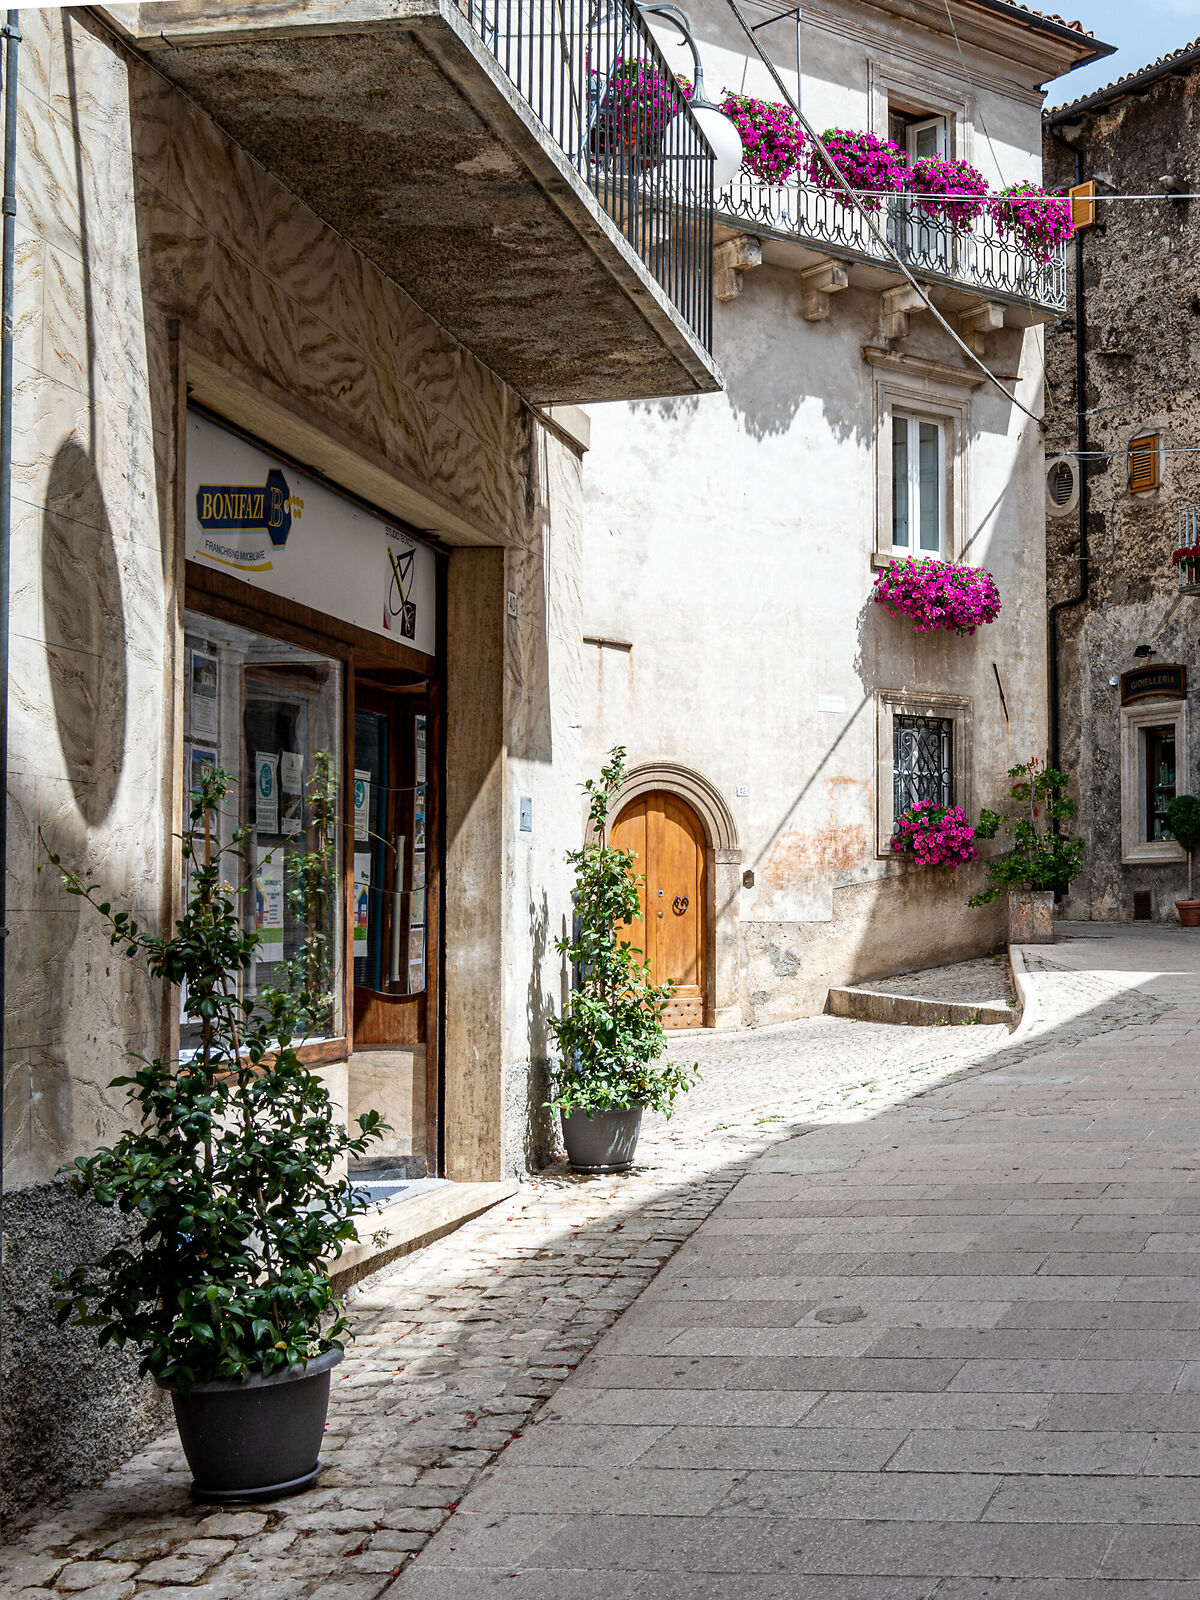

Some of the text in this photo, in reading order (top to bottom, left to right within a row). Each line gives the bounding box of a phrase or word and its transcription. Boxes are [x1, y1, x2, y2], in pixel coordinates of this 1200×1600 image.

[202, 493, 265, 520] BONIFAZI
[268, 486, 284, 527] B
[1131, 675, 1175, 690] GIOIELLERIA
